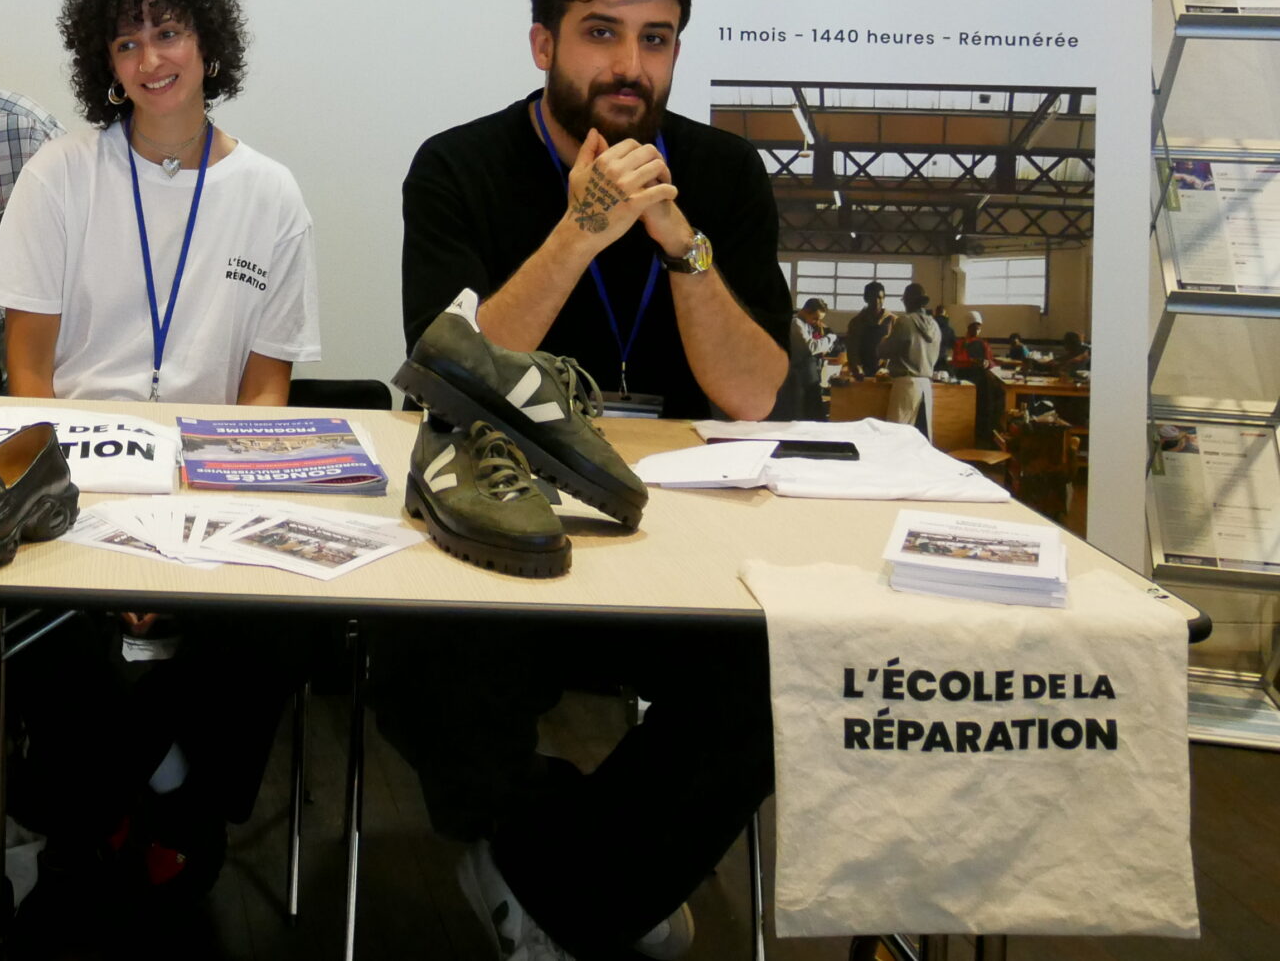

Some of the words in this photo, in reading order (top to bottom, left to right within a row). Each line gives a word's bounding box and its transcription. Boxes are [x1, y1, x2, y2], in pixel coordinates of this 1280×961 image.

[718, 27, 732, 41] 11
[740, 27, 787, 42] mois
[811, 29, 859, 44] 1440
[867, 29, 935, 45] heures
[959, 30, 1079, 48] Rémunérée
[69, 423, 109, 434] DE
[117, 423, 155, 437] LA
[215, 426, 317, 434] PROGRAMME
[226, 468, 342, 482] CONGRÈS
[843, 656, 1014, 702] L'ÉCOLE
[1022, 674, 1066, 699] DE
[1073, 674, 1116, 699] LA
[843, 706, 1118, 753] RÉPARATION
